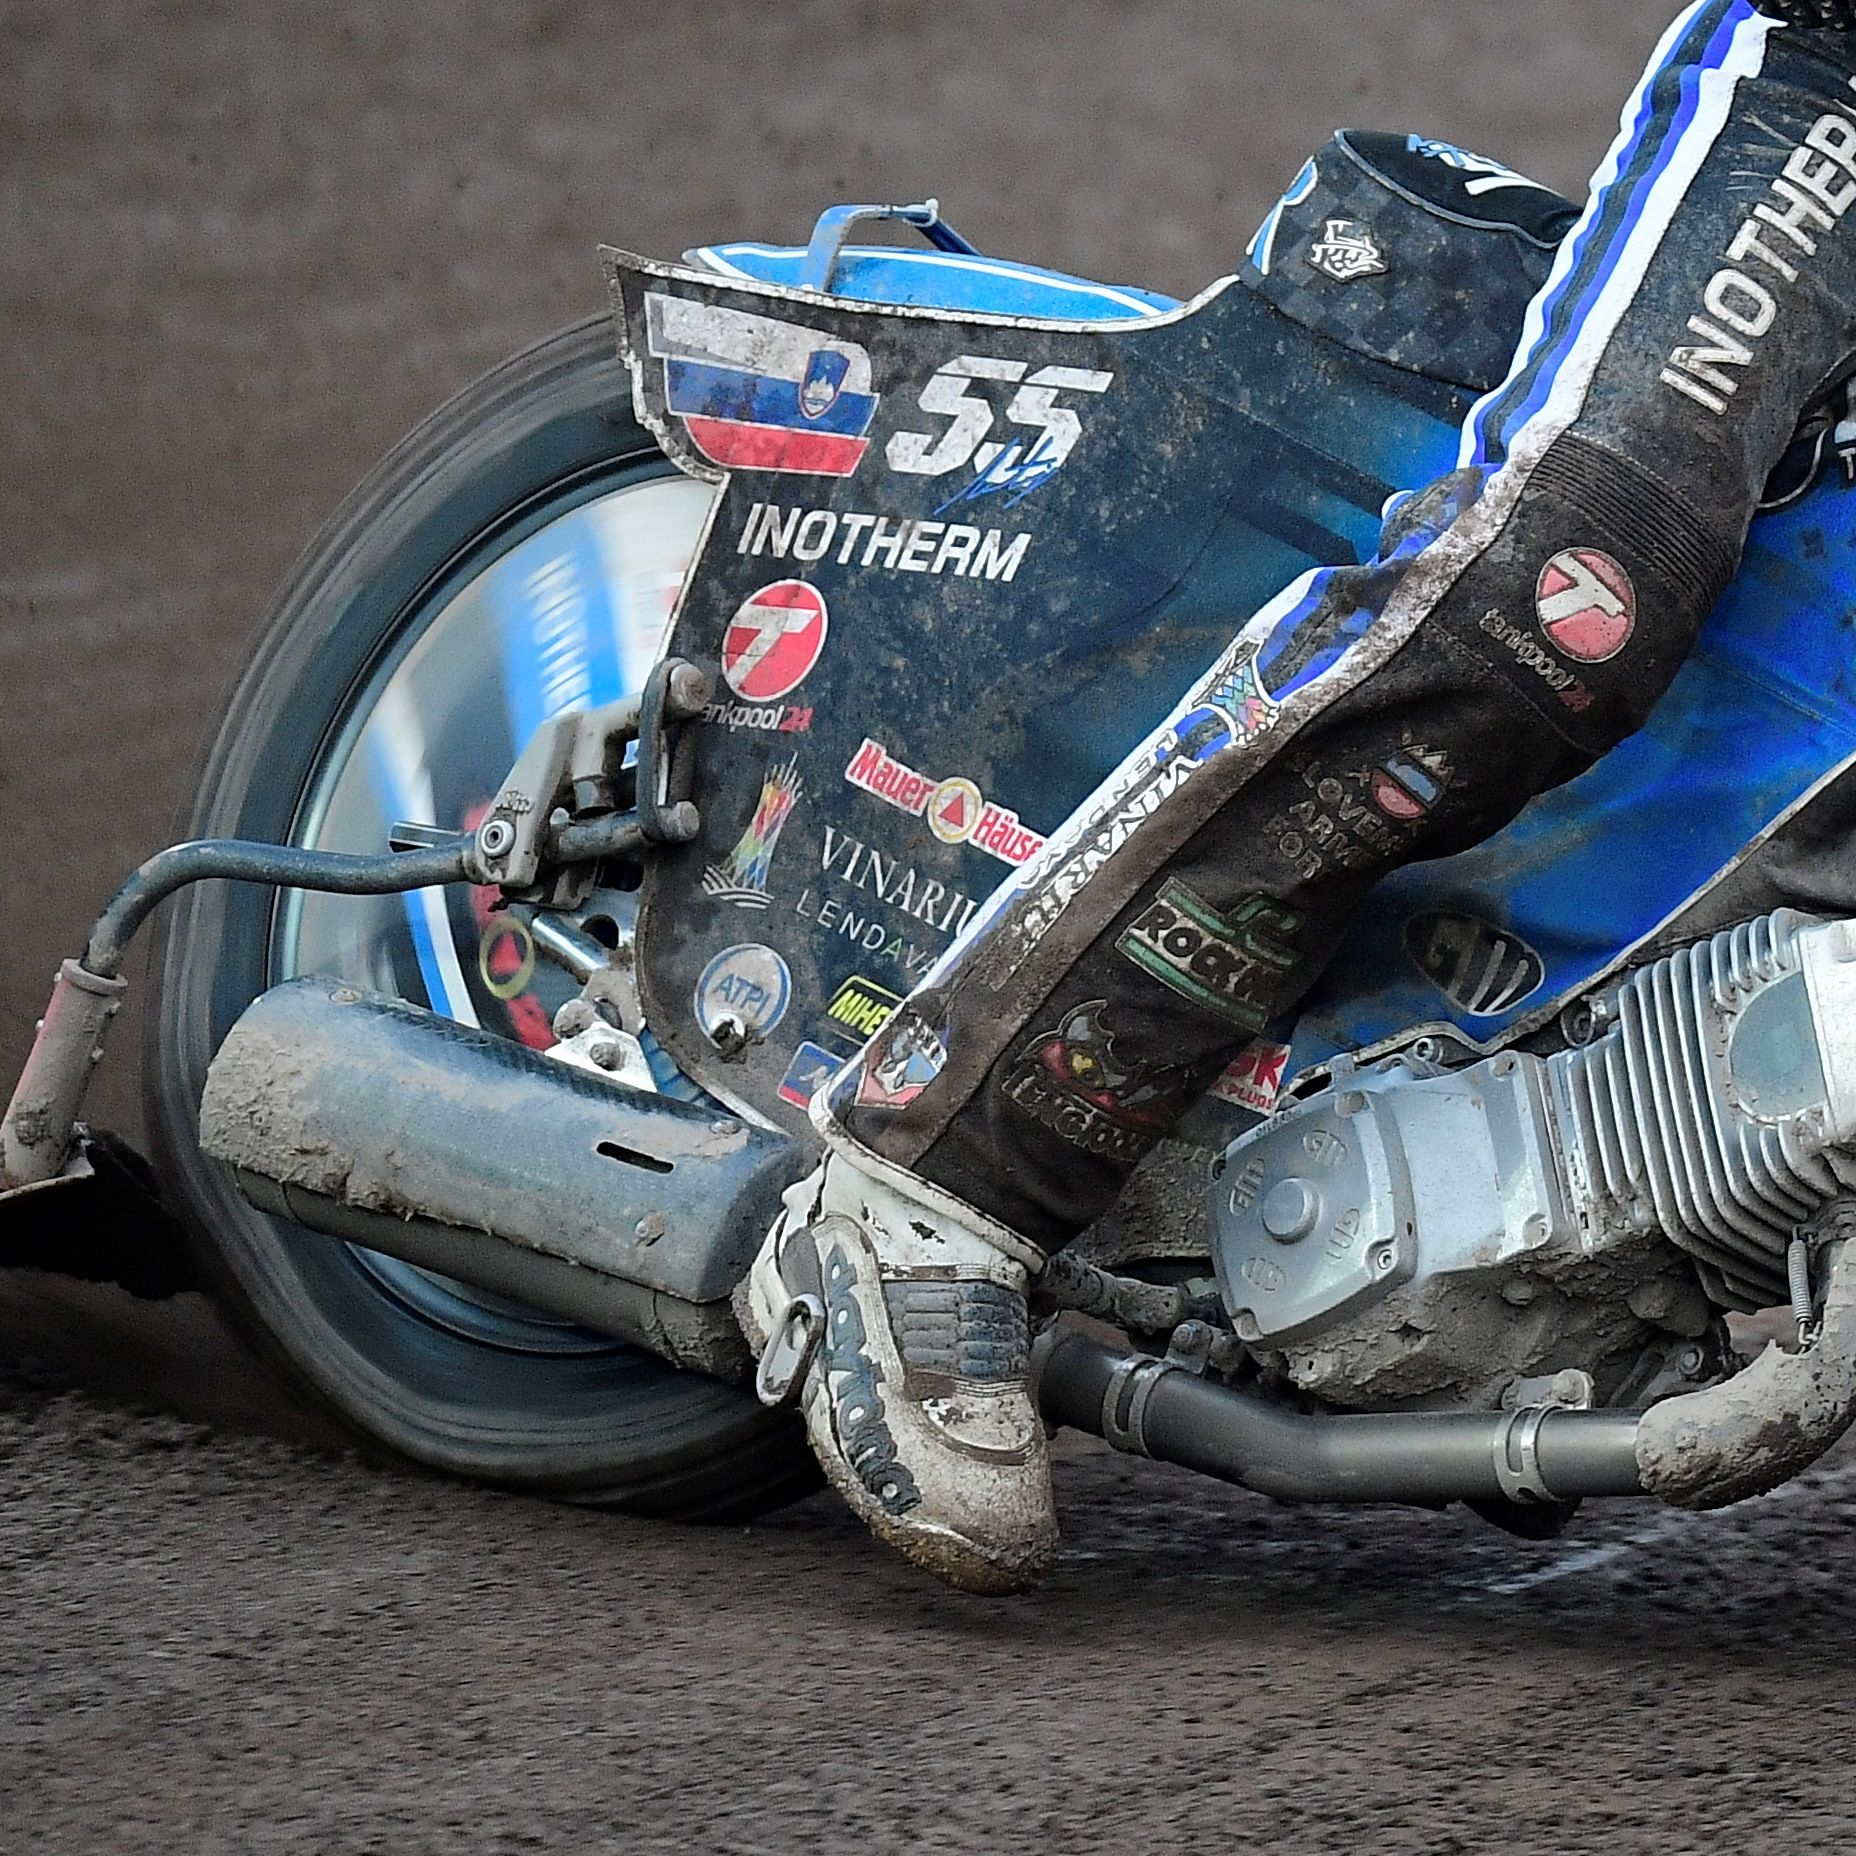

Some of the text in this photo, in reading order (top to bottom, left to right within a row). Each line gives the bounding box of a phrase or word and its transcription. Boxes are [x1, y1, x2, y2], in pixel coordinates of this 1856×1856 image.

[885, 355, 1114, 484] 55
[737, 502, 1031, 582] INOTHERM
[849, 744, 936, 812] Mauer
[714, 973, 771, 1014] ATPI
